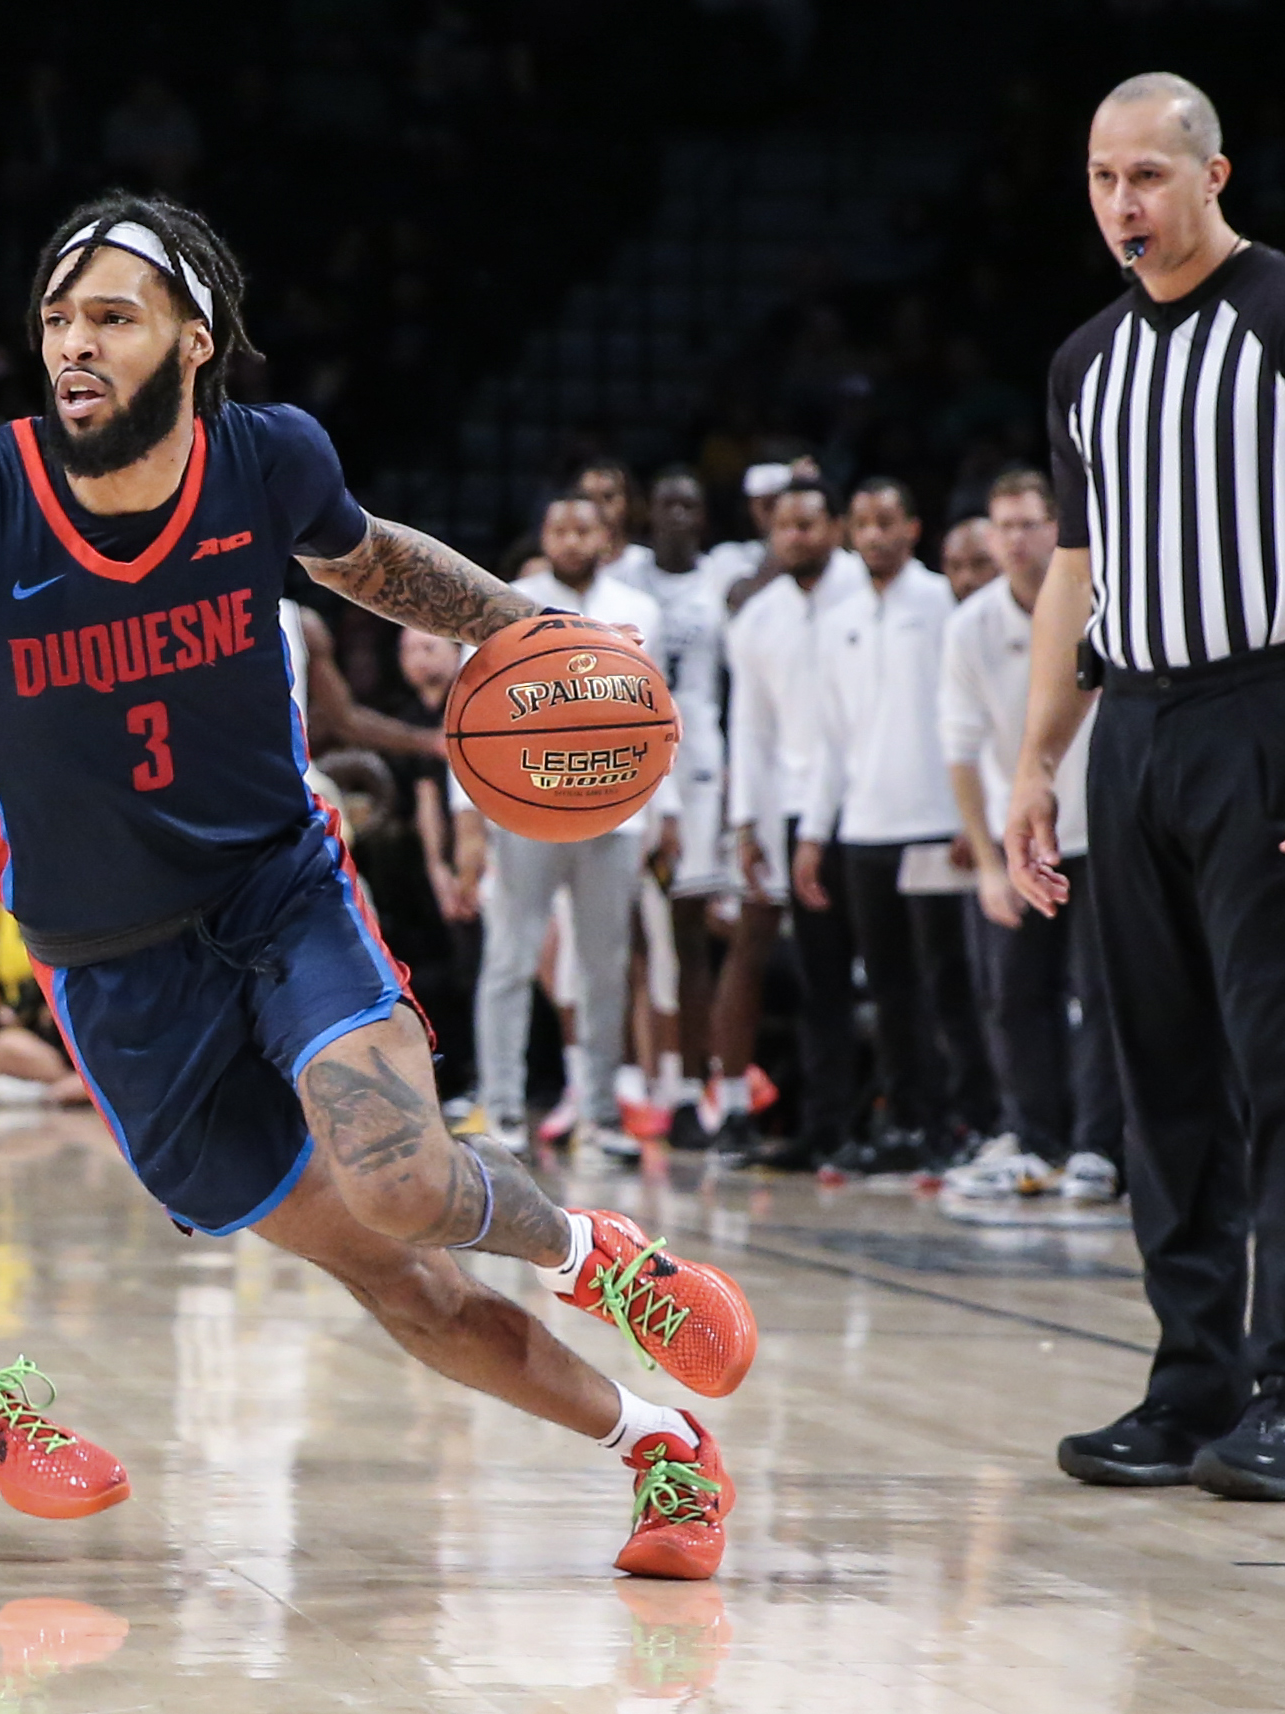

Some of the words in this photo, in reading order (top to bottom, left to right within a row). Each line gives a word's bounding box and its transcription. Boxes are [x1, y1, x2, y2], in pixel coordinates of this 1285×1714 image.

[190, 531, 253, 562] A10
[8, 588, 255, 697] DUQUESNE
[506, 675, 658, 722] SPALDING
[126, 701, 174, 792] 3
[520, 741, 648, 773] LEGACY
[562, 768, 639, 789] 1000
